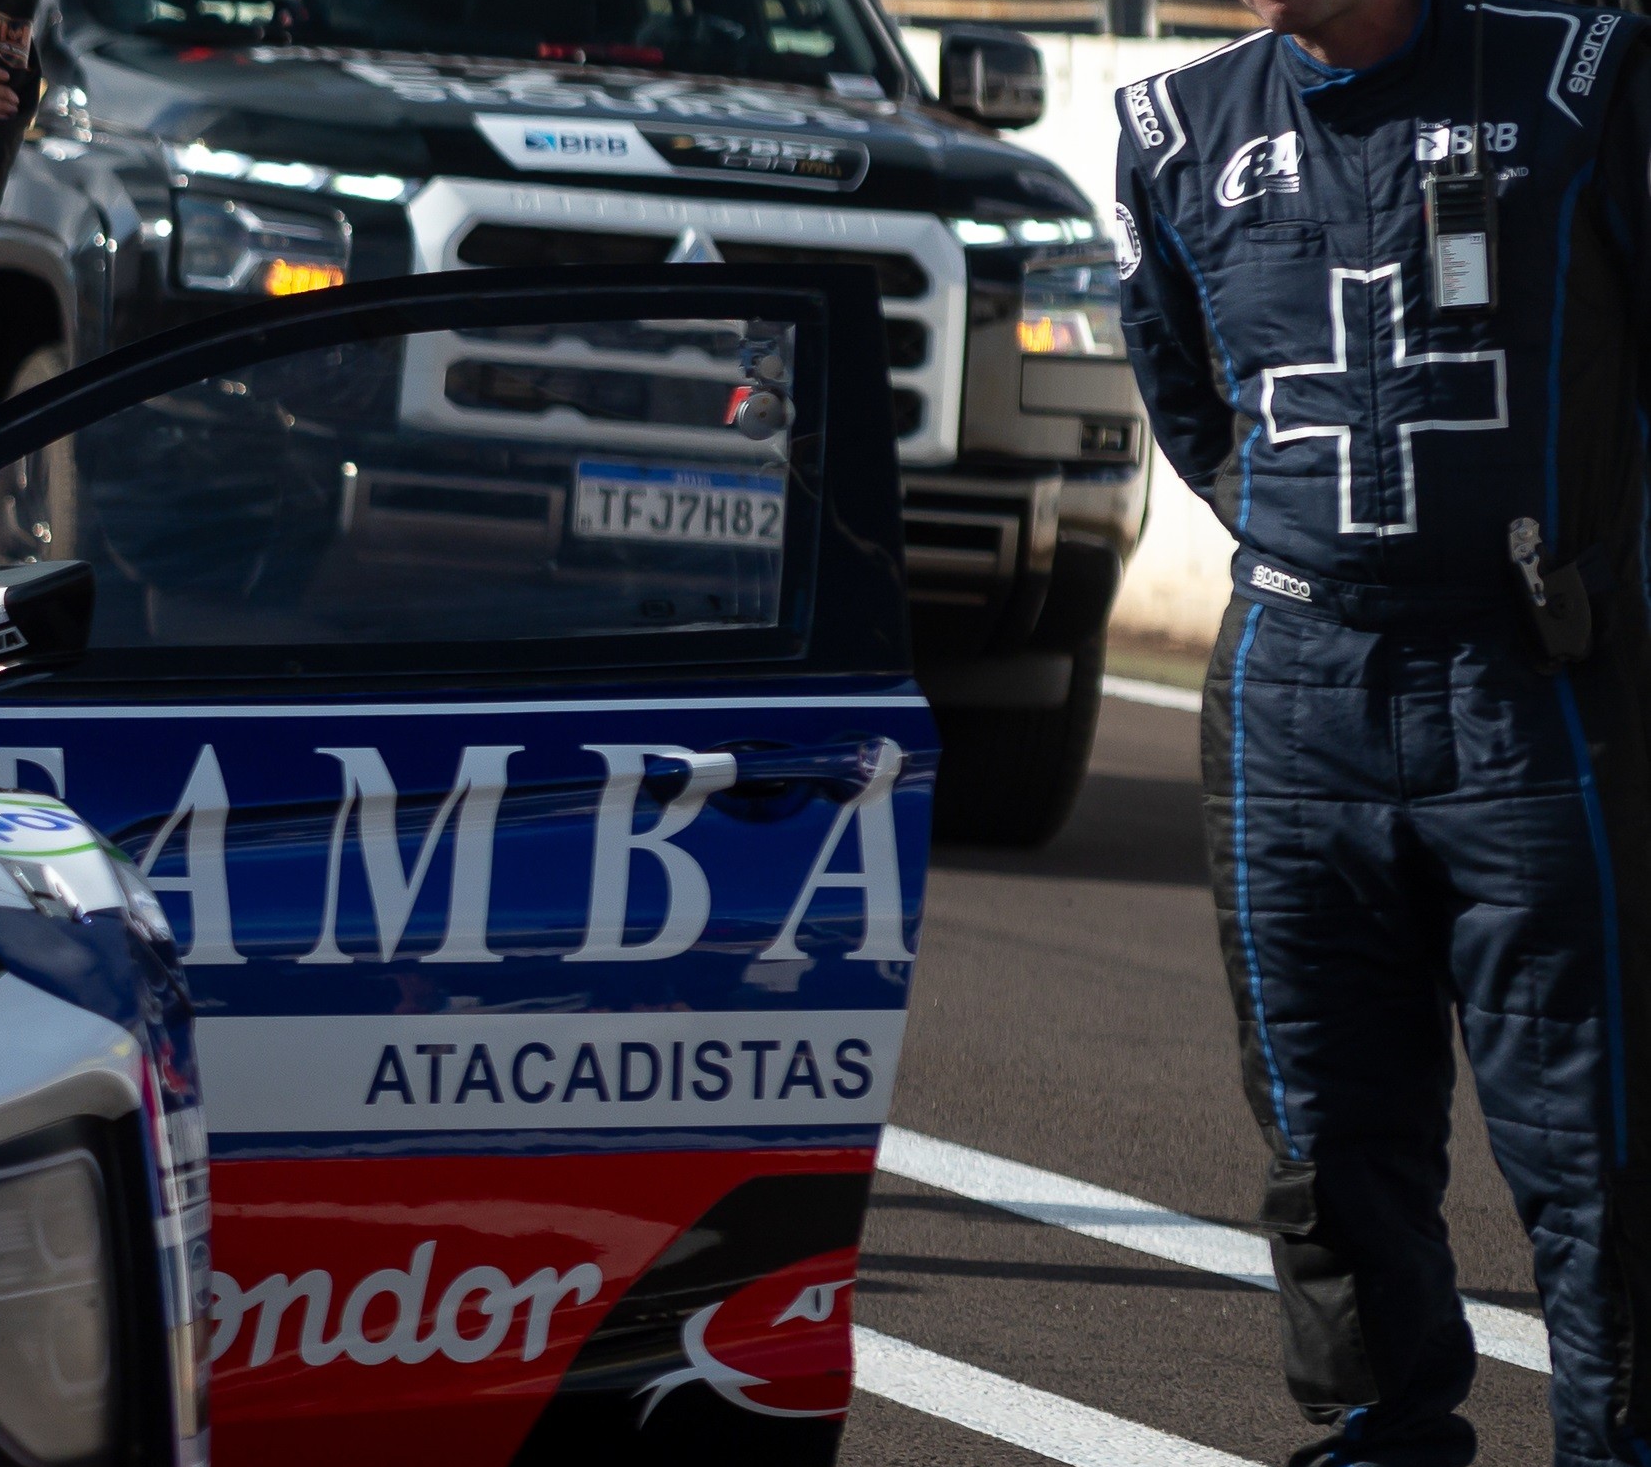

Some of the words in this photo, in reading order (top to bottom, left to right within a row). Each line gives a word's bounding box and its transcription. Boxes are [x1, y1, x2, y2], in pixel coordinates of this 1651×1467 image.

[1566, 12, 1616, 98] sparco
[558, 133, 631, 159] BRB
[597, 487, 782, 540] TFJ7H82
[1251, 562, 1313, 601] sparco
[363, 1036, 876, 1108] ATACADISTAS
[207, 1237, 605, 1368] ondor
